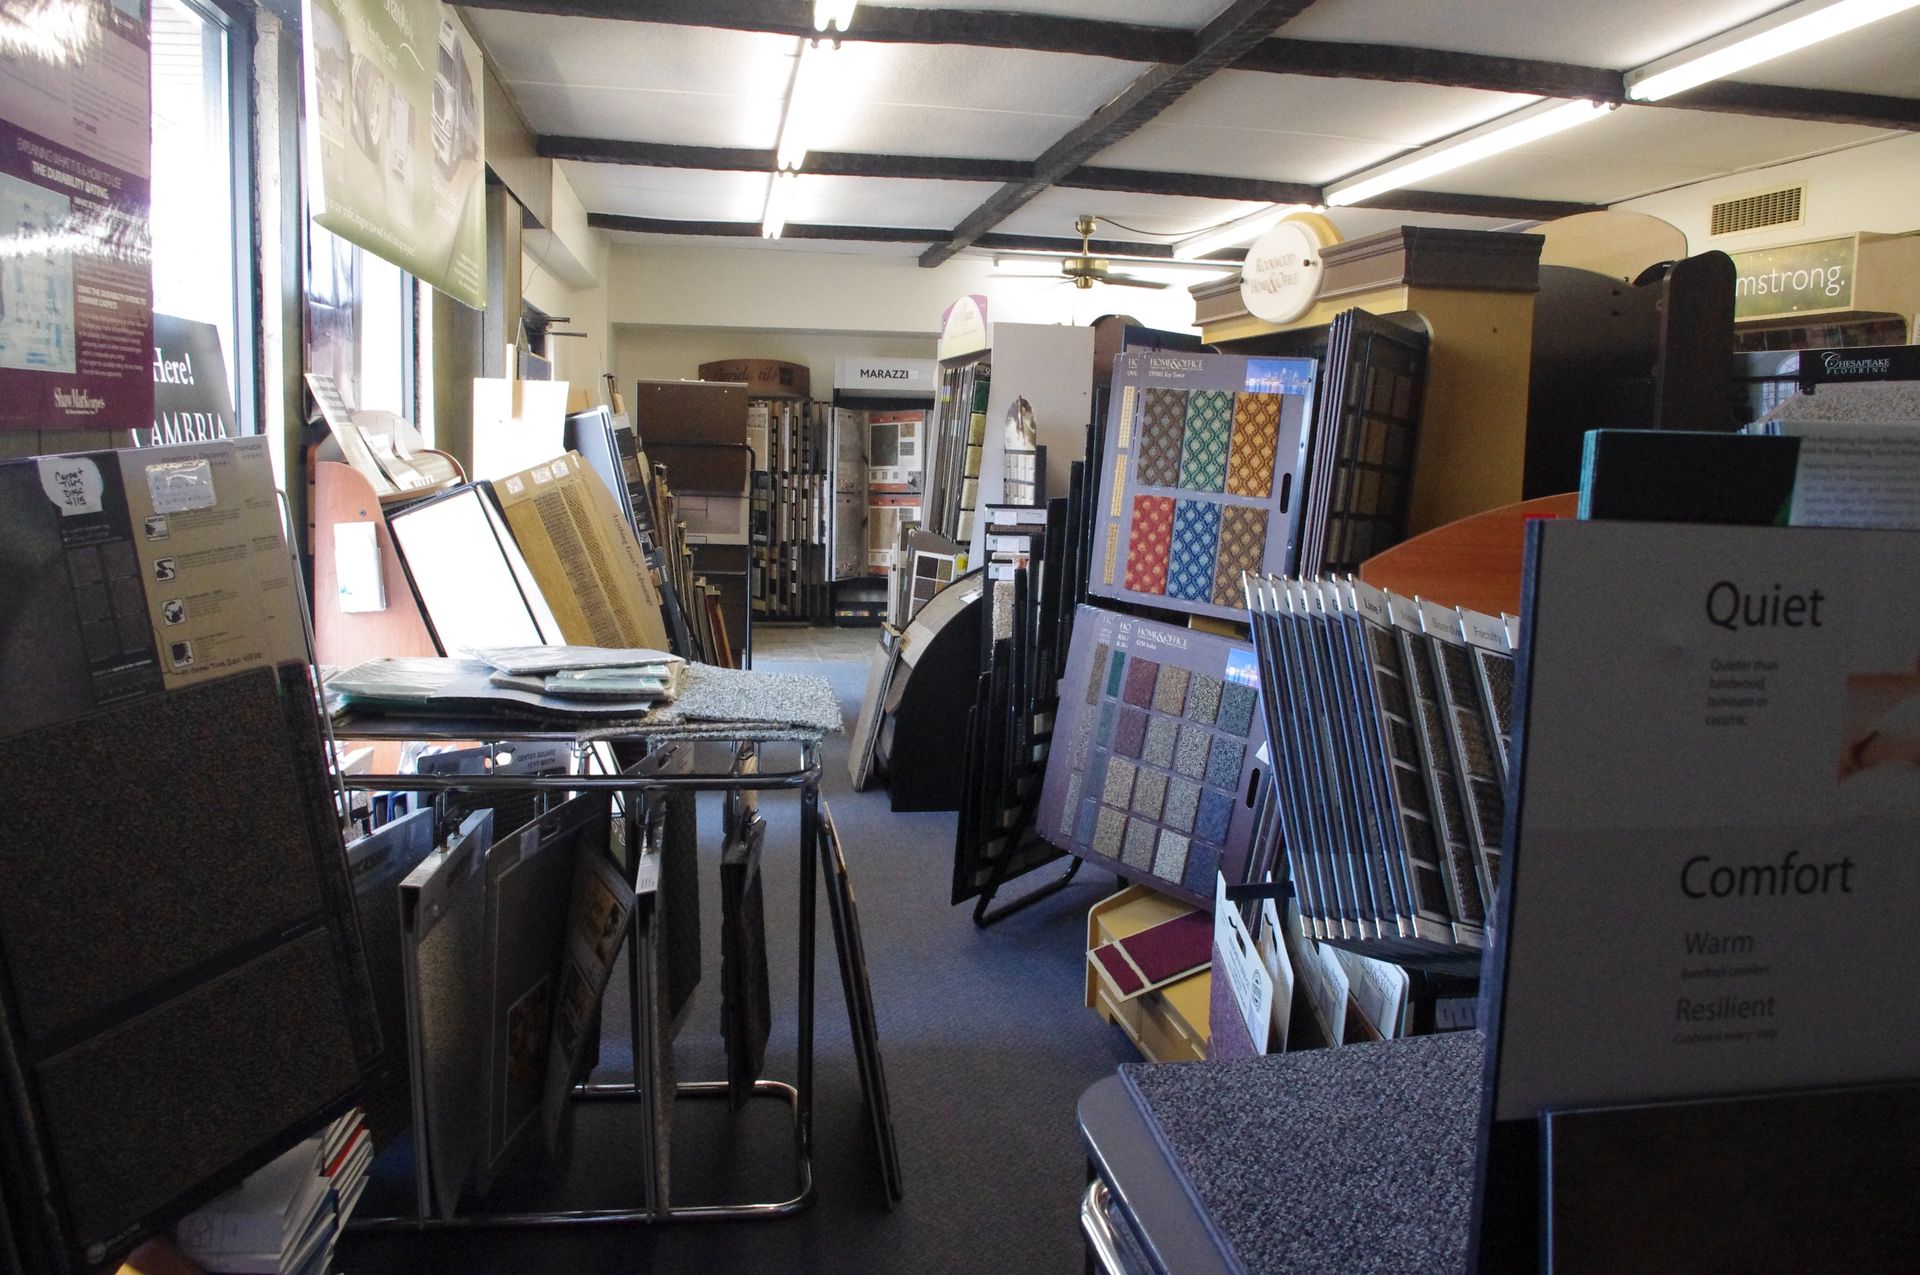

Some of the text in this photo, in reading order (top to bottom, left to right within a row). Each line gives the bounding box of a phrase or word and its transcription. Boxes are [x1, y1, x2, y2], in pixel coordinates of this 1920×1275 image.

[1735, 265, 1845, 297] mstrong.
[153, 347, 194, 385] Here!
[1820, 351, 1890, 370] CHESAPEAKE
[1825, 366, 1887, 375] FLOORING
[859, 369, 909, 380] MARAZZI
[1706, 580, 1825, 631] Quiet
[1680, 850, 1854, 899] Comfort
[1684, 932, 1754, 955] Warm
[1675, 995, 1775, 1022] Resilient
